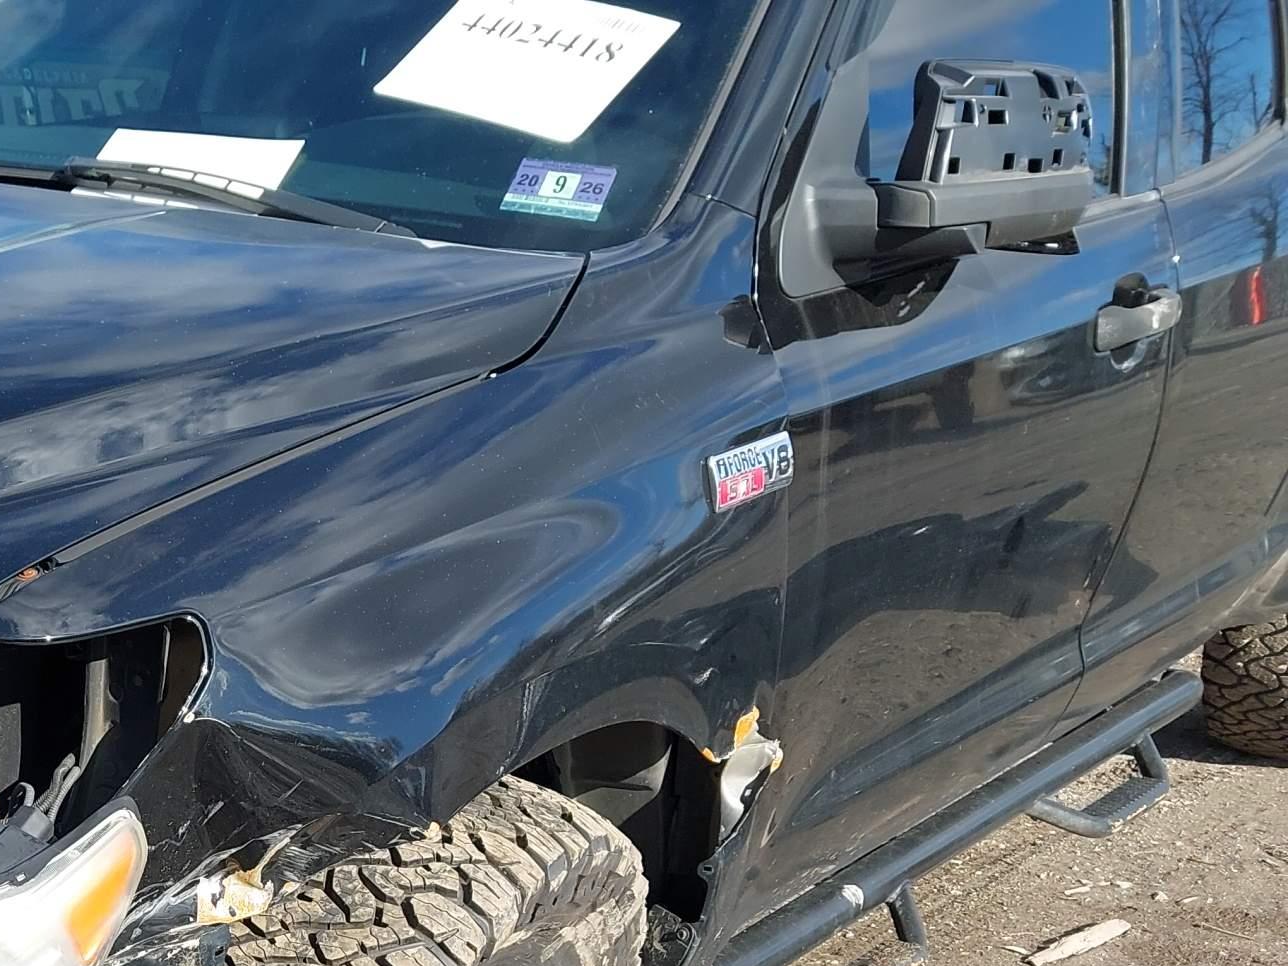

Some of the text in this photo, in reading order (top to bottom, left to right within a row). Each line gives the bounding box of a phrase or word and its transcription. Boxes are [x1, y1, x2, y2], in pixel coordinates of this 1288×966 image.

[461, 13, 624, 63] 44024418
[516, 173, 606, 195] 20 9 26
[762, 444, 791, 481] V8
